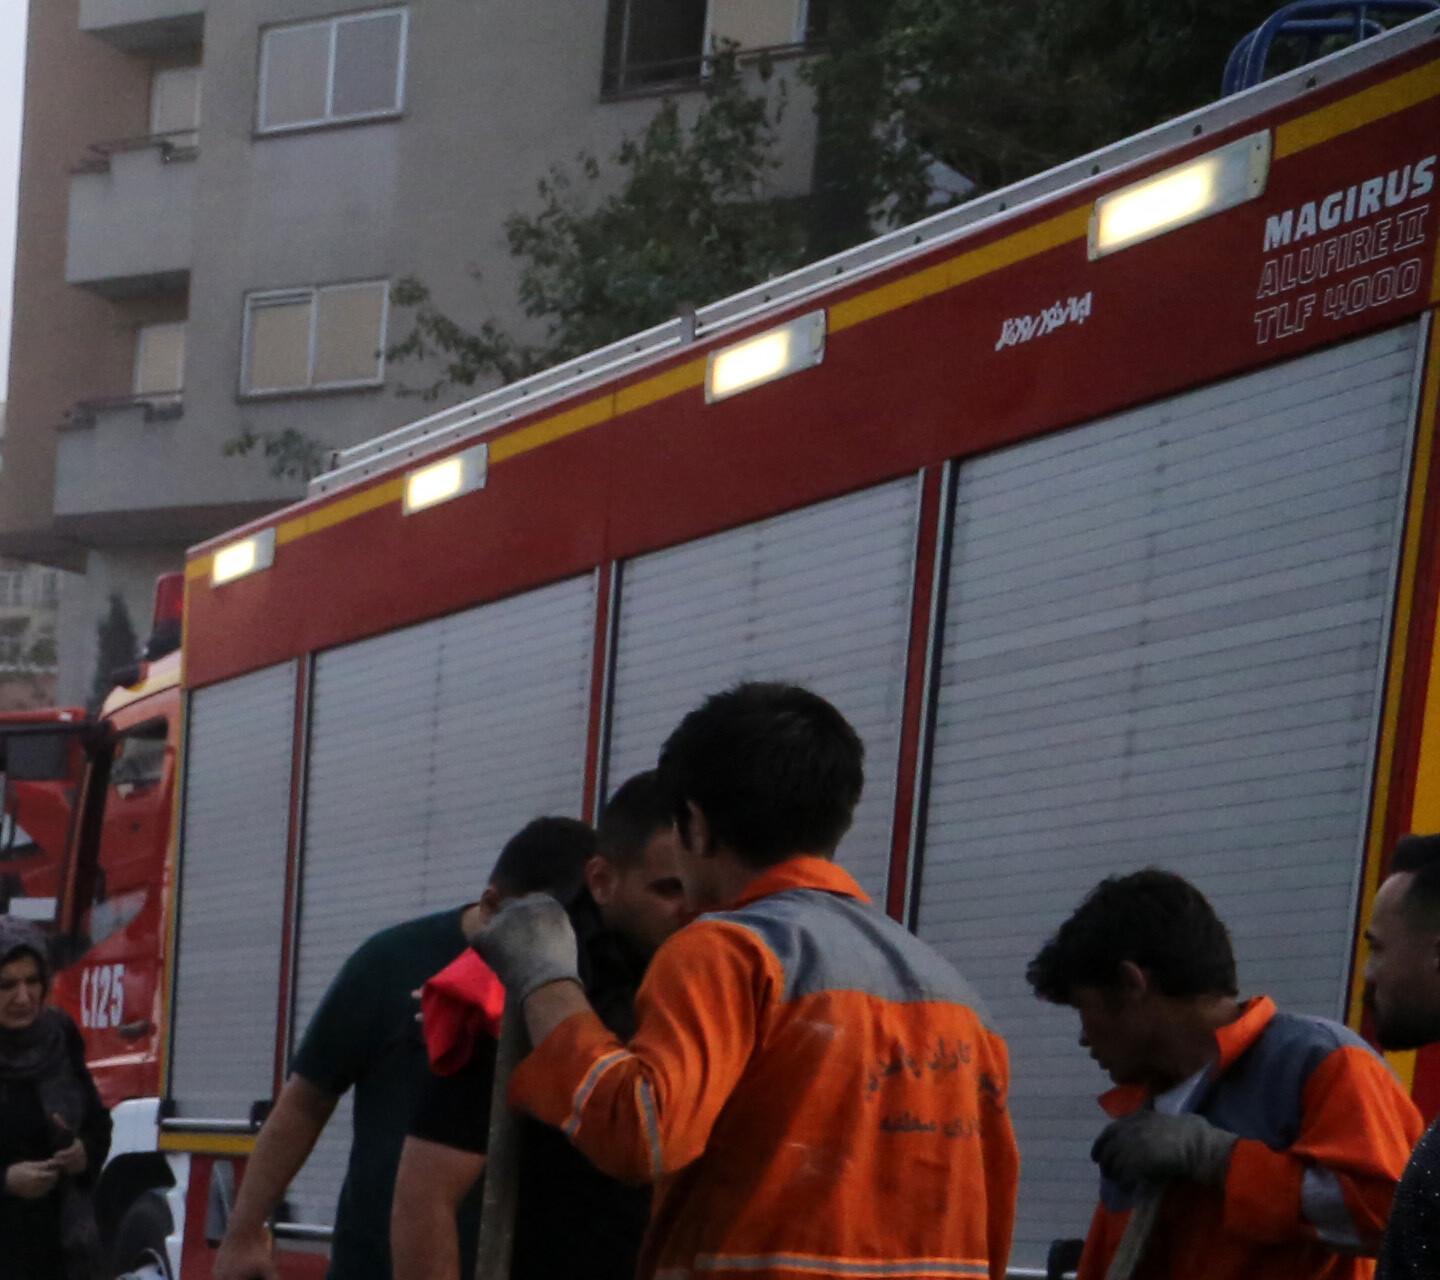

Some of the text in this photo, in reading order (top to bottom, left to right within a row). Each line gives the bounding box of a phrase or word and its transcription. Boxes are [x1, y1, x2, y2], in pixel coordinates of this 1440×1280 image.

[1263, 155, 1437, 253] MAGIRUS
[1256, 204, 1430, 299] ALUFIRE II
[1254, 257, 1423, 344] TLF 4000
[91, 964, 125, 1030] 125
